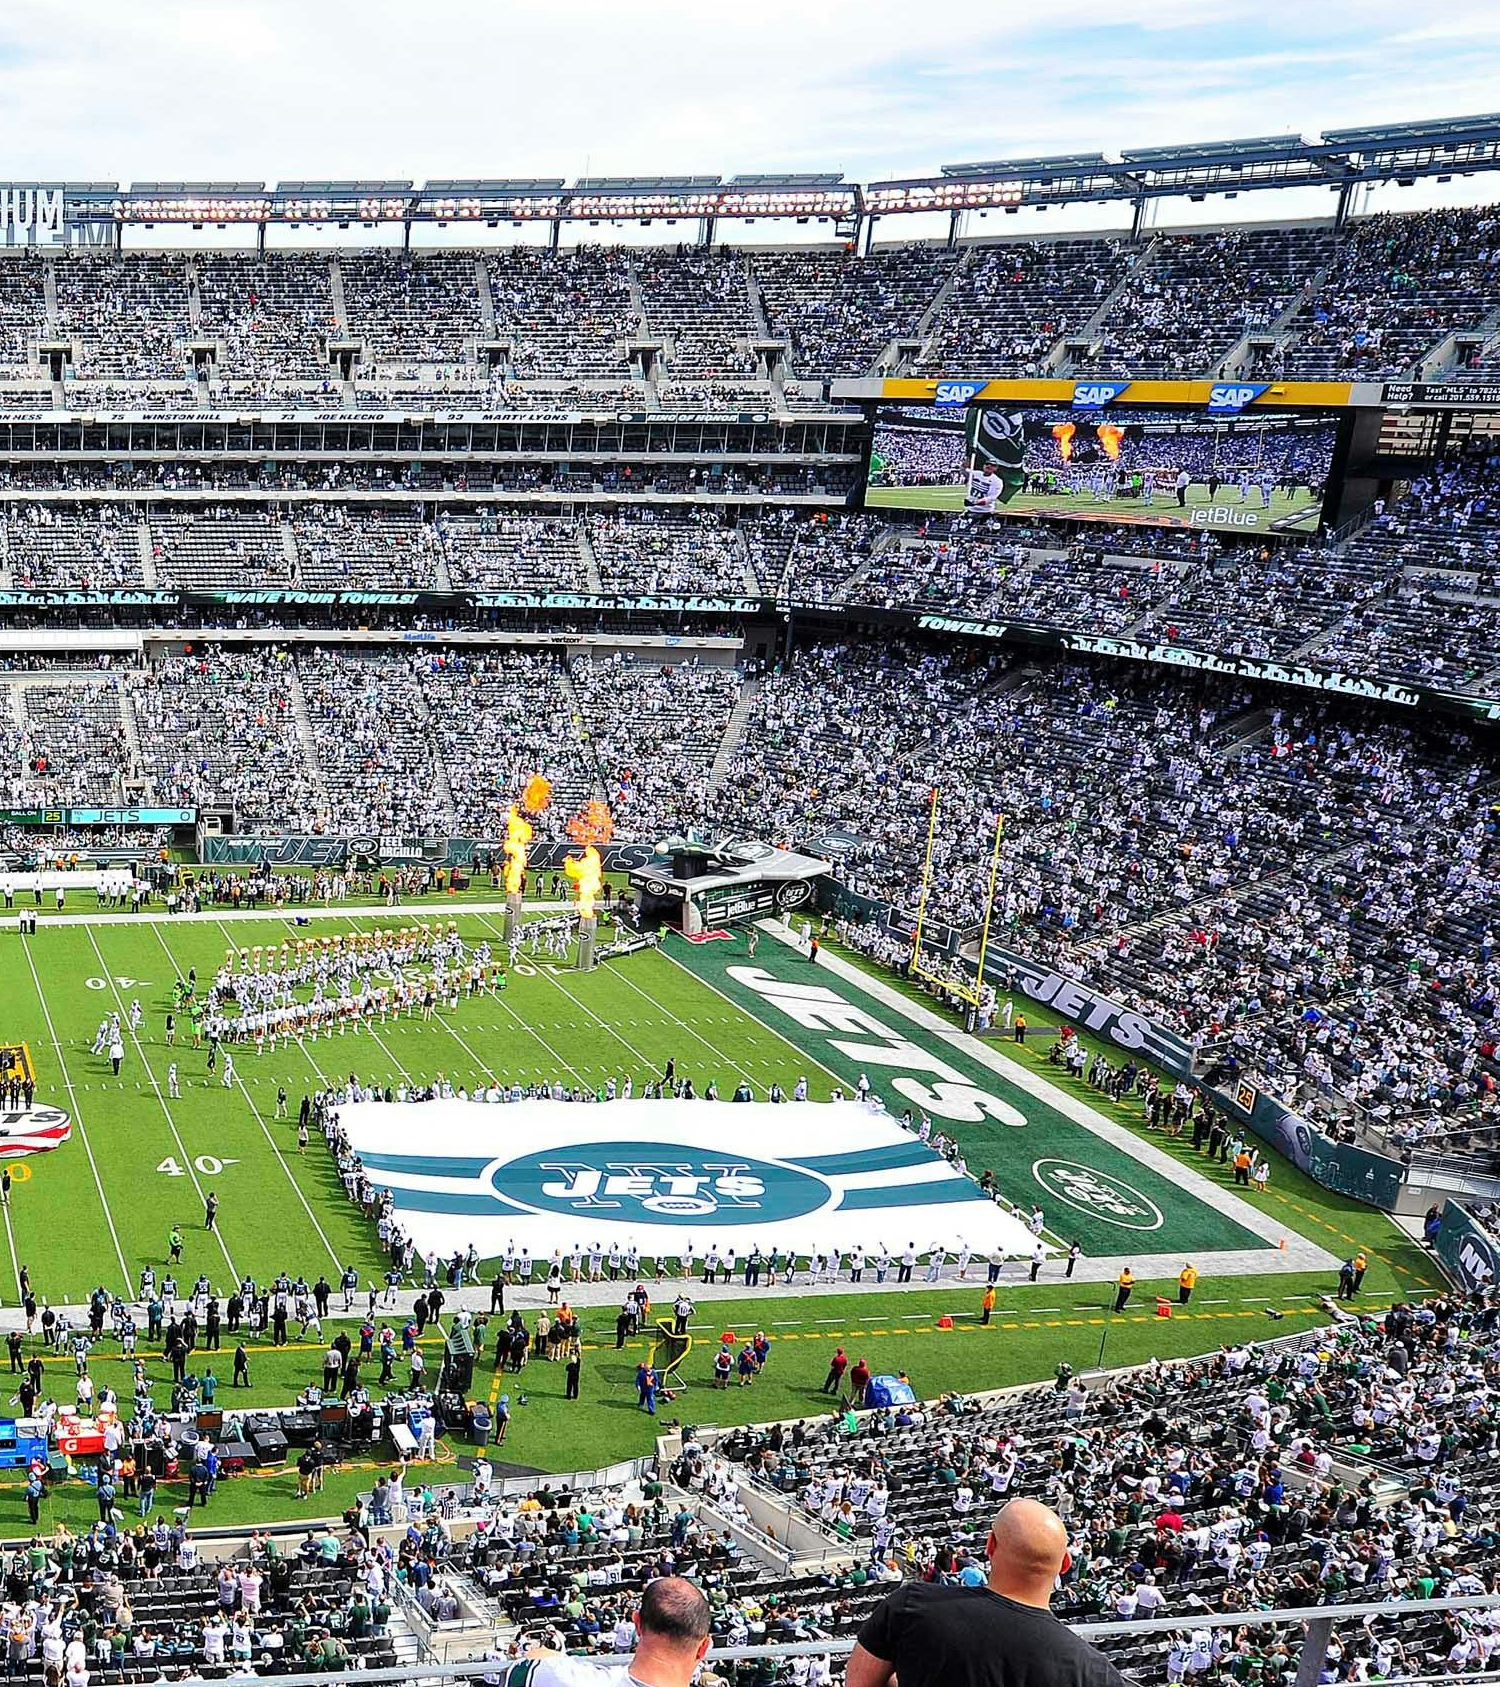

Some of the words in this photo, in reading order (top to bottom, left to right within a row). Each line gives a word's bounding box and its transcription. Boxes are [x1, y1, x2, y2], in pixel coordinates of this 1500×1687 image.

[938, 385, 975, 402] SAP
[1388, 384, 1412, 393] Need
[1426, 386, 1443, 394] Text
[1074, 386, 1114, 405] SAP
[1209, 387, 1253, 406] SAP
[1387, 393, 1414, 401] Help?
[111, 413, 125, 421] 75
[142, 413, 194, 422] WINSTON
[196, 413, 222, 421] HILL
[314, 413, 338, 421] JOE
[338, 413, 384, 421] KLECKO
[482, 413, 528, 422] MARTY
[528, 413, 569, 422] LYONS
[1188, 505, 1258, 526] jetBlue
[225, 591, 282, 604] WAVE
[283, 591, 337, 604] YOUR
[339, 591, 419, 606] TOWELS!
[918, 615, 1009, 638] TOWELS!
[403, 633, 437, 641] MetLife
[550, 636, 581, 644] verizon
[45, 811, 61, 821] 25
[92, 810, 140, 822] JETS
[179, 810, 191, 822] 0
[379, 837, 403, 848] FEEL
[725, 899, 756, 918] jetBlue
[1020, 973, 1153, 1049] JETS
[725, 965, 1028, 1127] JETS
[1238, 1085, 1253, 1108] 25
[157, 1155, 224, 1177] 40
[542, 1170, 766, 1199] JETS
